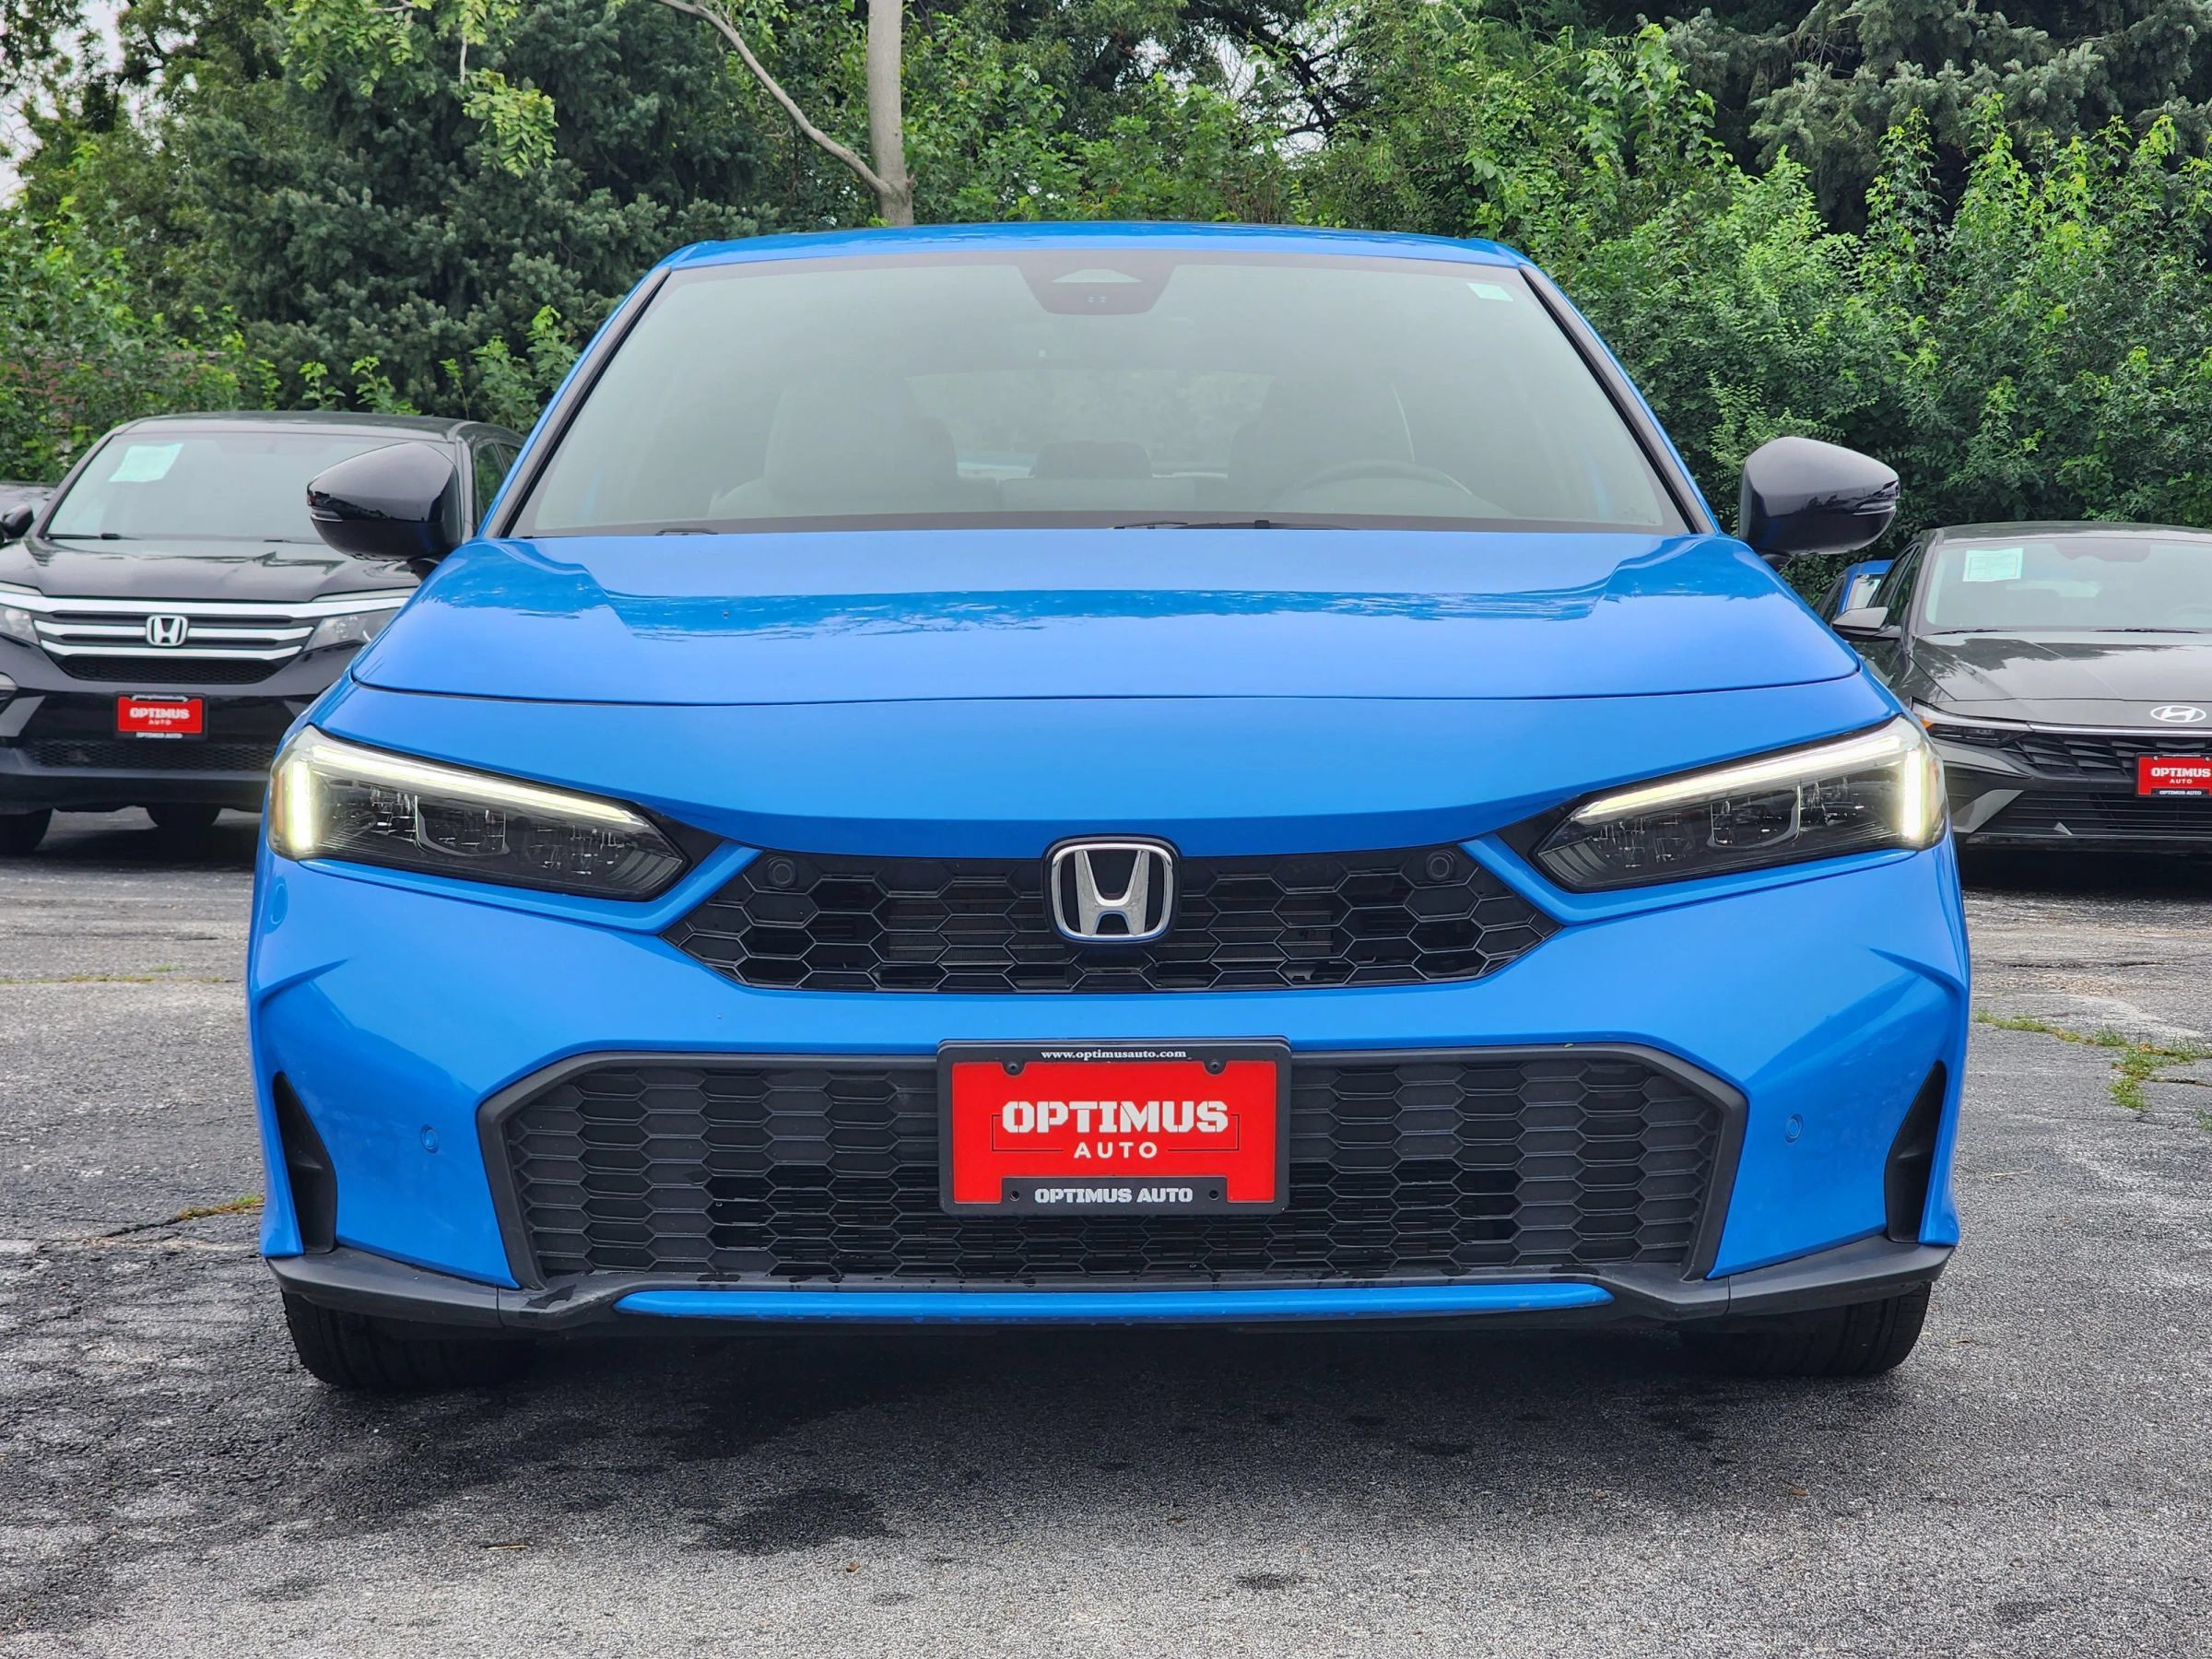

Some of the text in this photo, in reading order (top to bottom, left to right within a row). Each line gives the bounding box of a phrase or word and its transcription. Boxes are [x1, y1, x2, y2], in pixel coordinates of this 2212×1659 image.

[130, 707, 190, 719] OPTIMUS
[2150, 768, 2211, 777] OPTIMUS
[1041, 1050, 1186, 1061] www.optimusauto.com
[1002, 1100, 1229, 1133] OPTIMUS
[1073, 1141, 1158, 1159] AUTO
[1034, 1187, 1193, 1203] OPTIMUS AUTO
